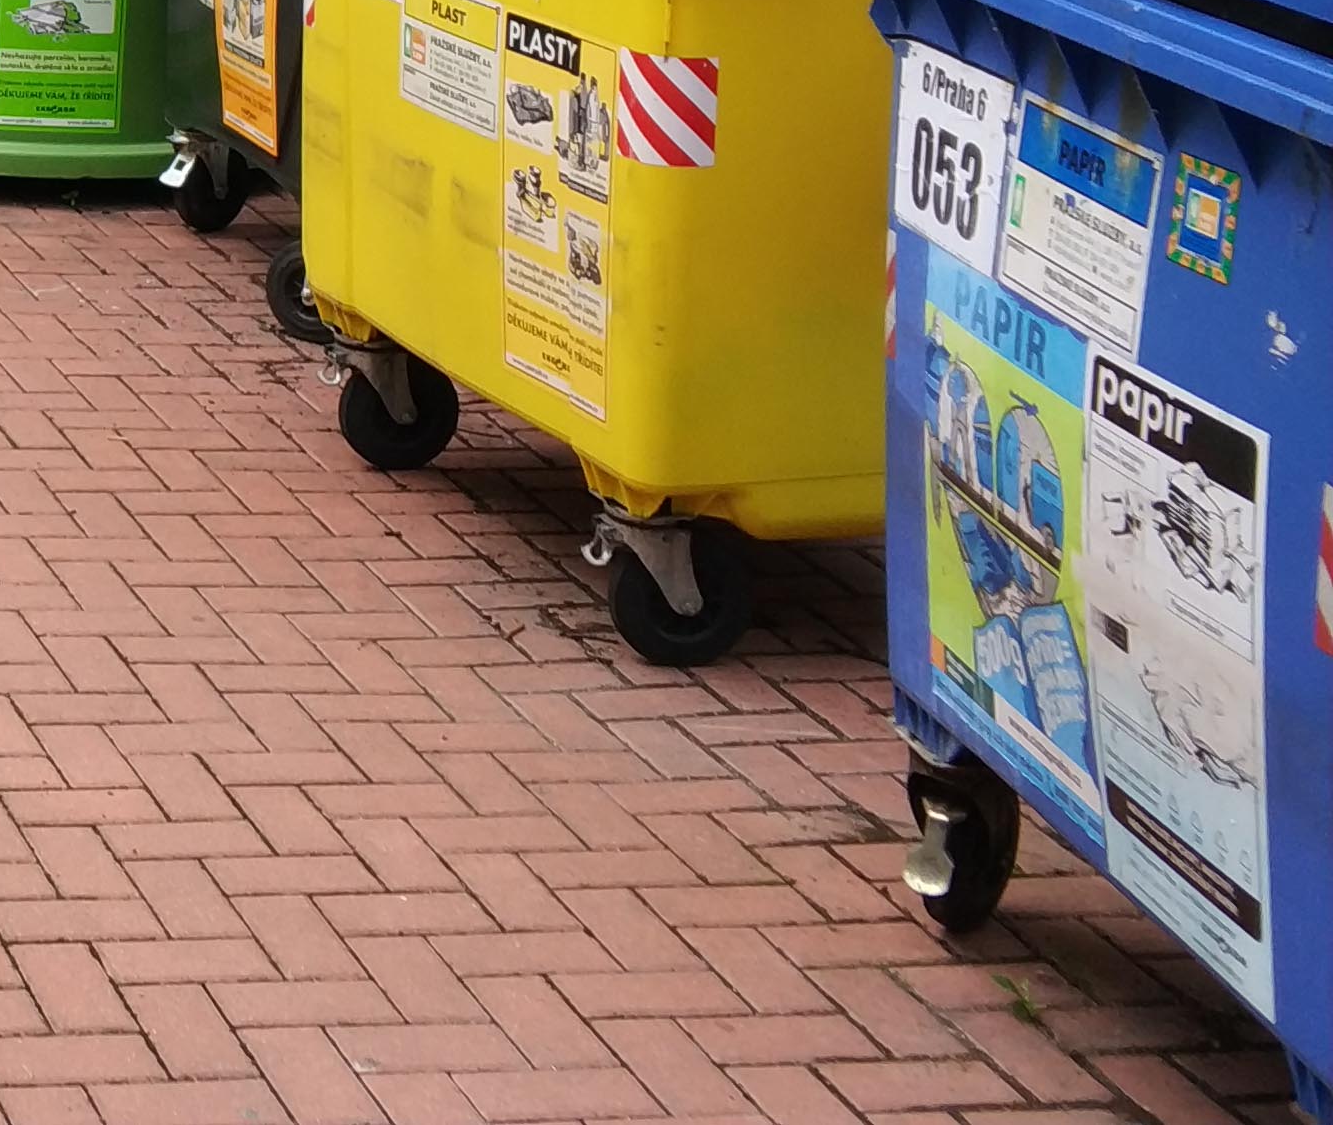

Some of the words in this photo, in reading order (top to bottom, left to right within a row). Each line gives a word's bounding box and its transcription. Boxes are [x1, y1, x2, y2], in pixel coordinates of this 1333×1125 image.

[431, 0, 466, 26] PLAST
[509, 19, 578, 70] PLASTY
[978, 88, 988, 122] 6
[912, 117, 983, 241] 053
[507, 312, 548, 343] DĚKUJEME
